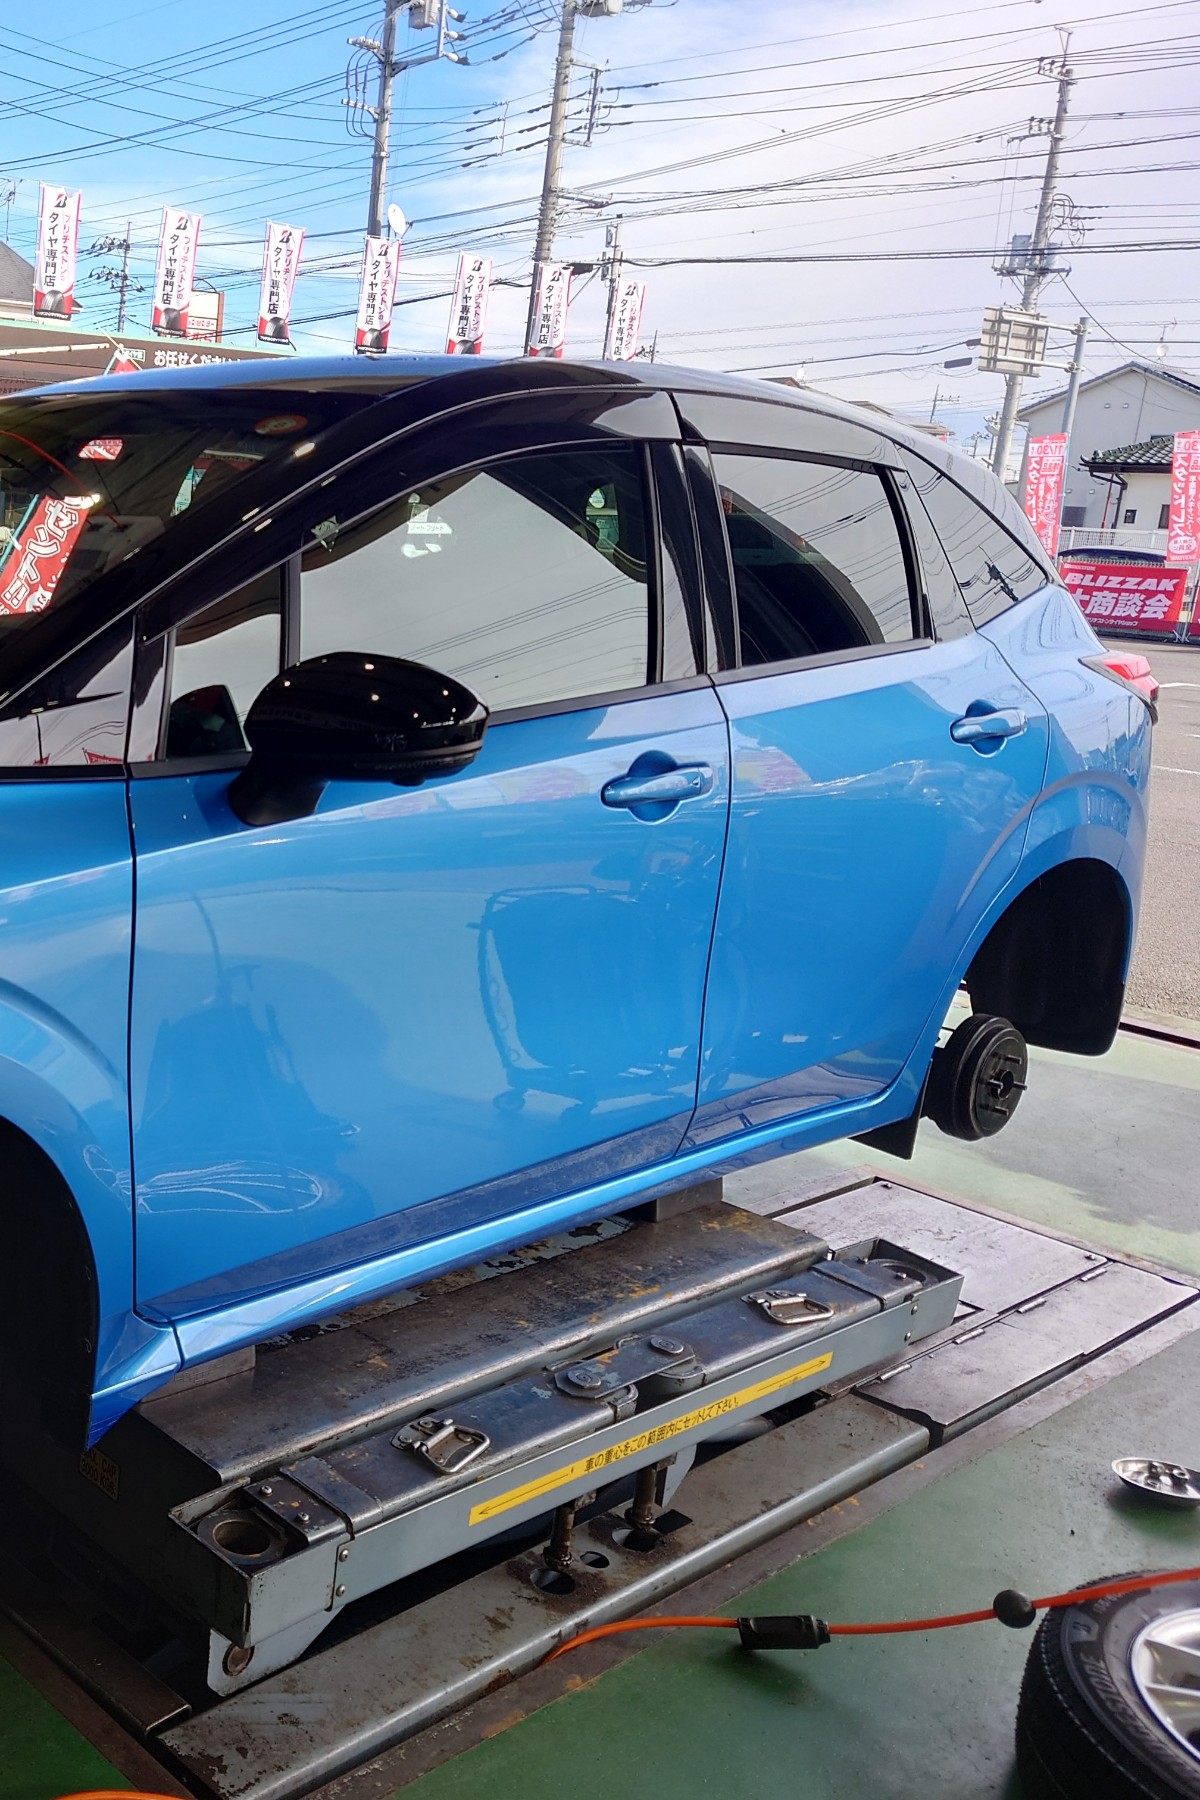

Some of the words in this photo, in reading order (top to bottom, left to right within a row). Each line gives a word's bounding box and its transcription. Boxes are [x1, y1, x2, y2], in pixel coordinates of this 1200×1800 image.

[162, 234, 179, 305] タイヤ専門店
[365, 260, 380, 325] タイヤ専門店
[456, 274, 474, 337] タイヤ専門店
[538, 284, 554, 344] タイヤ専門店
[1064, 572, 1180, 591] BLIZZAK
